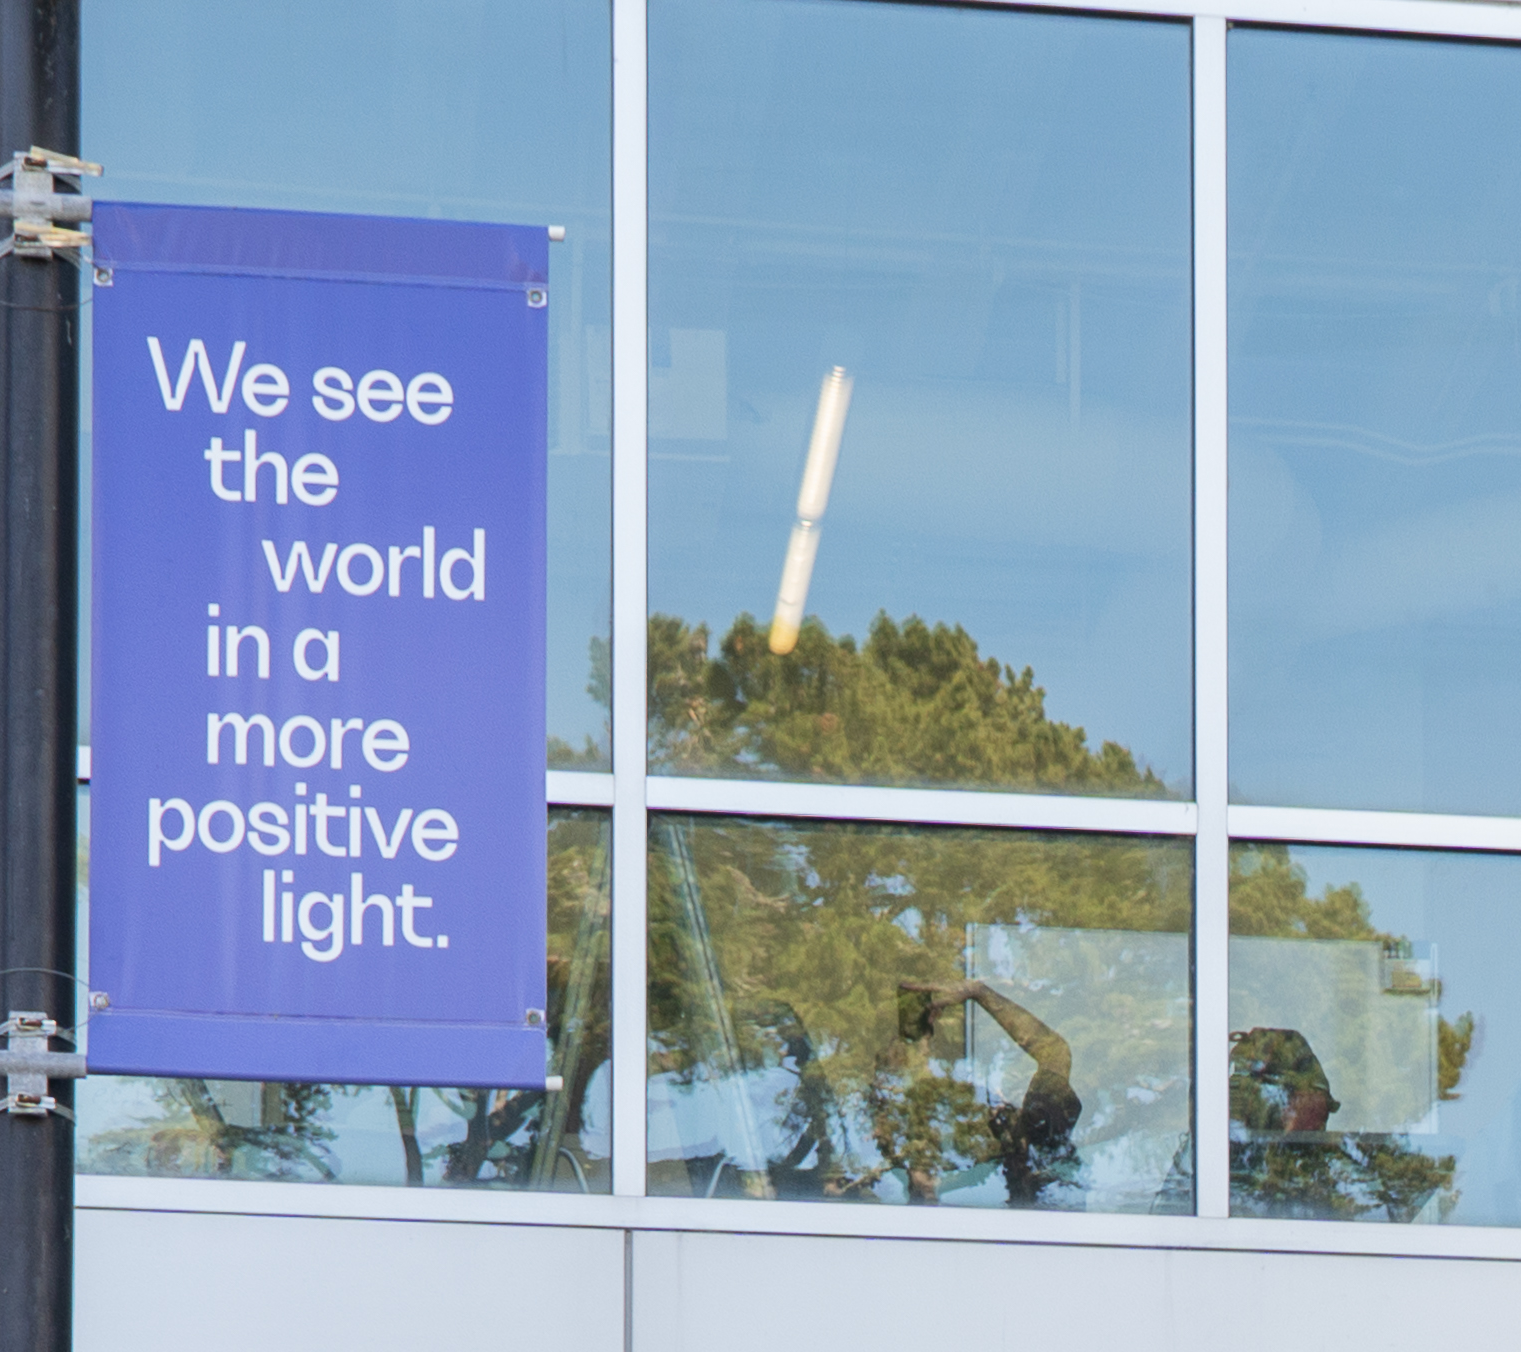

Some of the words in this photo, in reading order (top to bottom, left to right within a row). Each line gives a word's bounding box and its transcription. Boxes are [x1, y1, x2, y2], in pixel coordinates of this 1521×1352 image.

[147, 336, 290, 418] We
[312, 366, 454, 426] see
[204, 428, 339, 506] the
[261, 525, 485, 601] world
[207, 603, 270, 679] in
[293, 627, 340, 682] a
[207, 712, 410, 772] more
[148, 782, 459, 867] positive
[263, 869, 449, 962] light.
